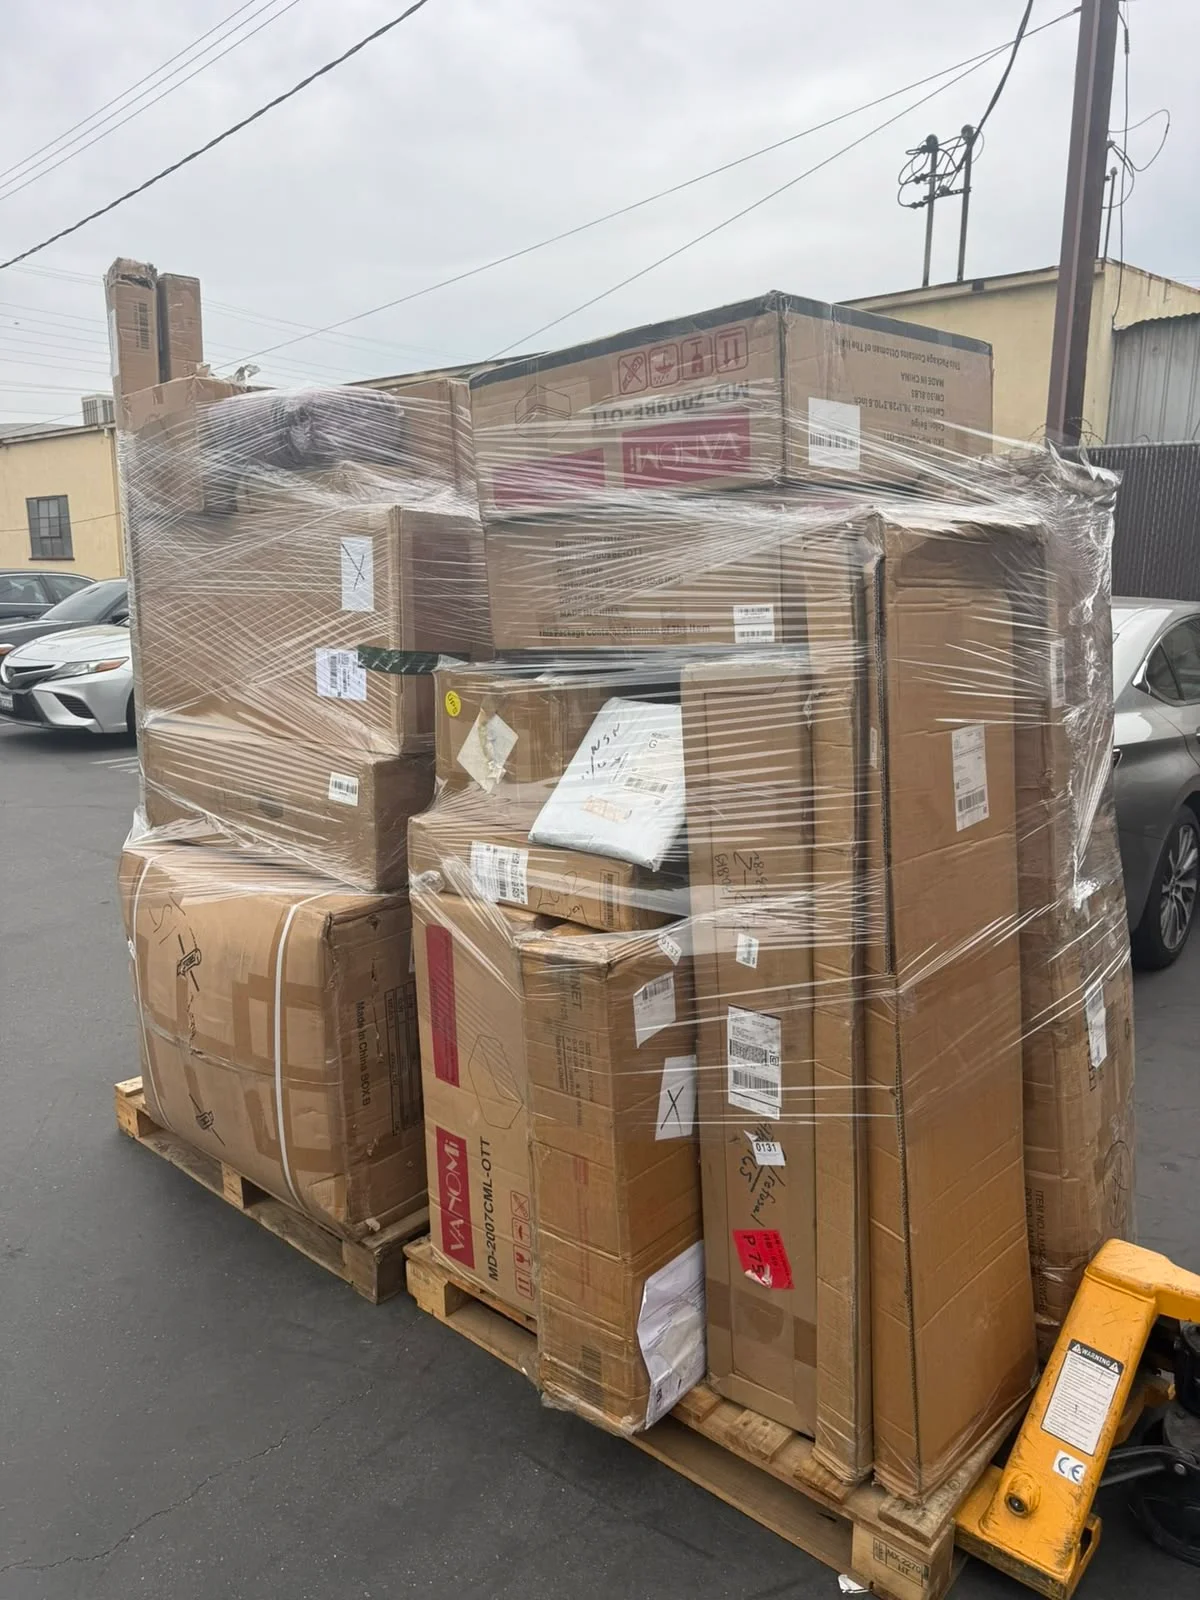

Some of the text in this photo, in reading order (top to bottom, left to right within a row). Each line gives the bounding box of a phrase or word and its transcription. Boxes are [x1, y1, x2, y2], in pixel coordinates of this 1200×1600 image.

[852, 341, 863, 352] The
[864, 344, 871, 353] of
[873, 345, 899, 358] Ottoman
[900, 350, 925, 363] Contains
[927, 355, 949, 368] Package
[949, 359, 960, 370] This
[901, 372, 944, 388] MADE IN CHINA
[926, 407, 944, 417] Carton
[911, 418, 927, 429] Beige
[355, 1001, 366, 1029] Made
[359, 1042, 369, 1072] China
[756, 1142, 777, 1153] 0131
[1035, 1190, 1045, 1212] ITEM
[480, 1136, 499, 1281] MD-2007CML-OTT
[1082, 1348, 1111, 1367] WARNING
[1058, 1456, 1085, 1483] CE
